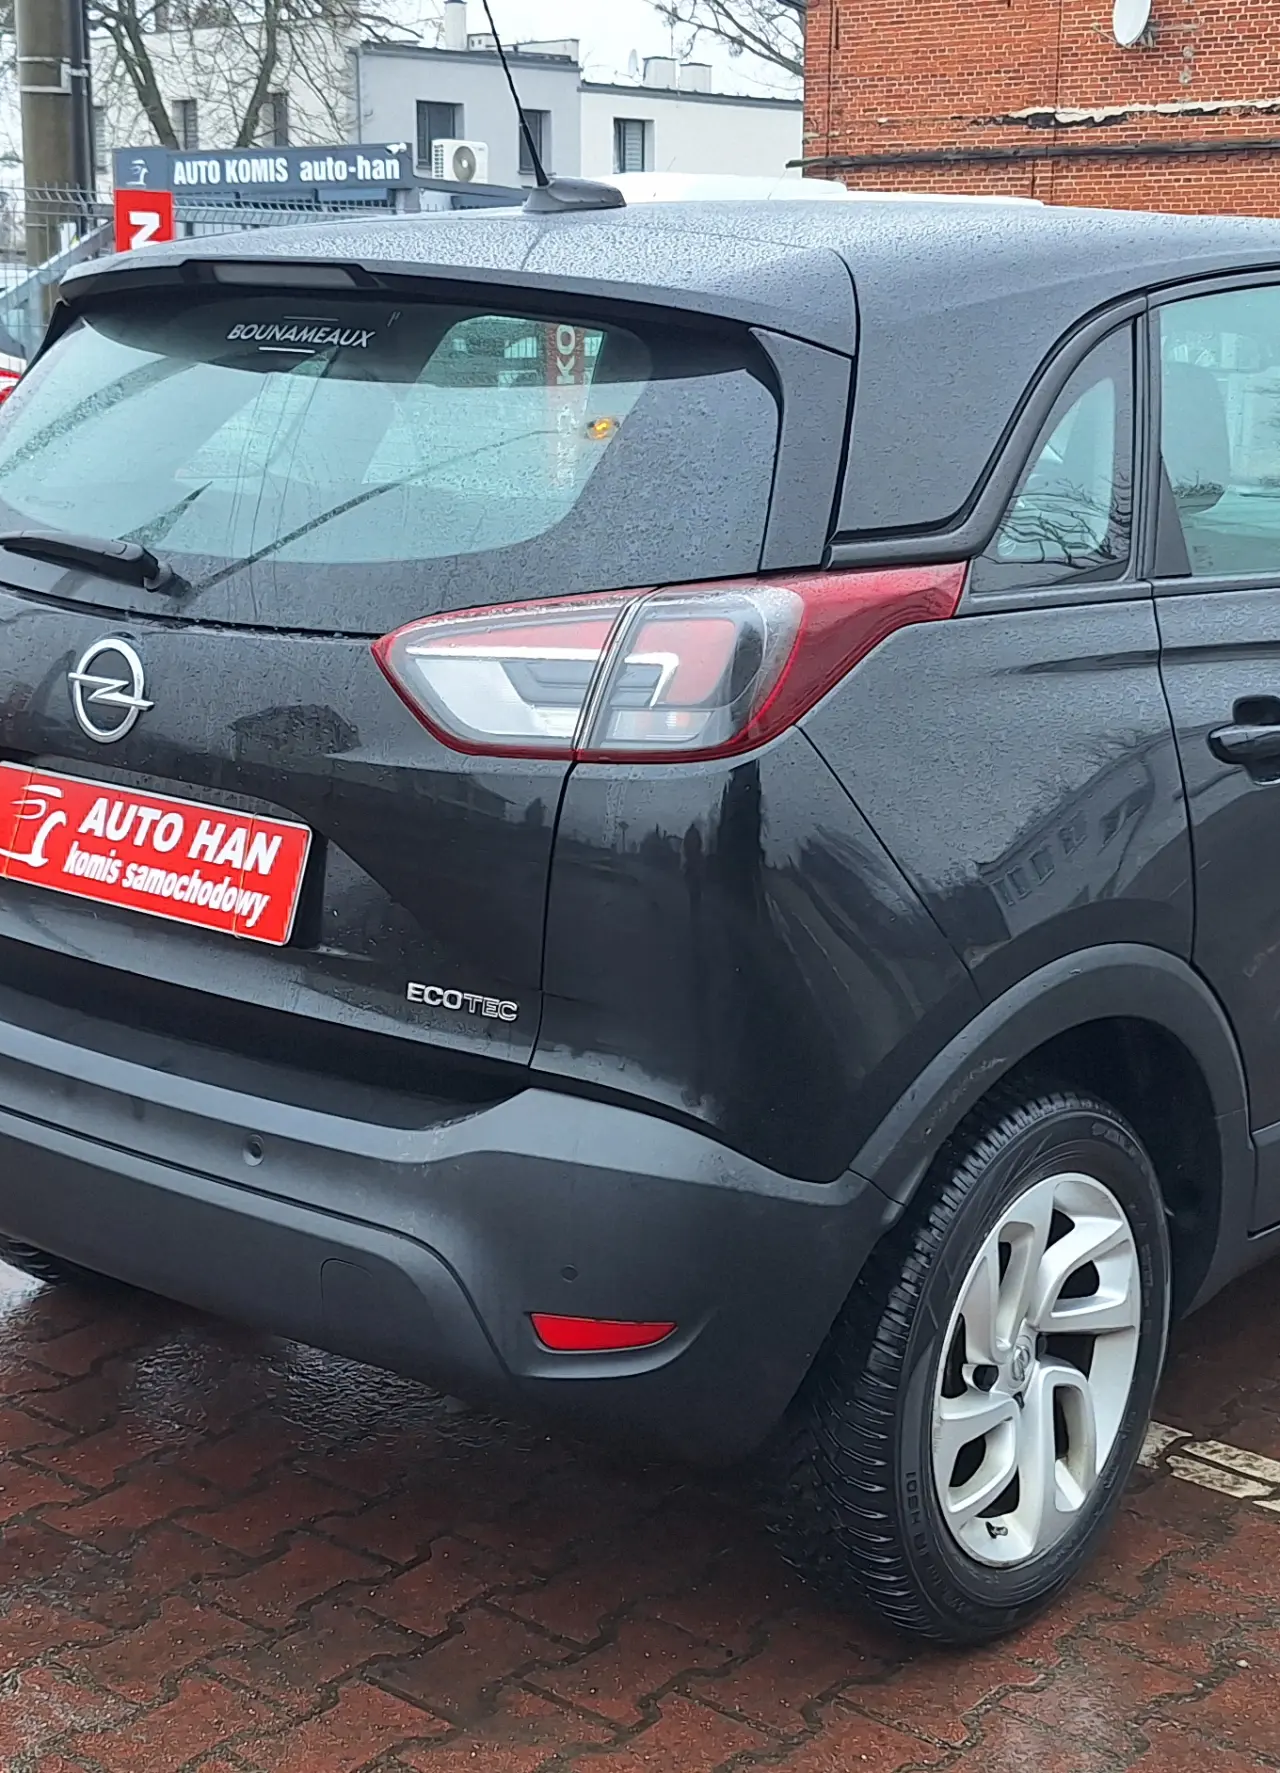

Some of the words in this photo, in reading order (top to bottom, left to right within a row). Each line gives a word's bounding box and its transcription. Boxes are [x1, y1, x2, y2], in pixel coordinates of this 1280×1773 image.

[173, 159, 221, 185] AUTO
[225, 157, 289, 183] KOMIS
[299, 155, 401, 182] auto-han
[227, 324, 375, 347] BOUNAMEAUX
[78, 797, 184, 853] AUTO
[187, 819, 283, 876] HAN
[62, 840, 124, 885] komis
[121, 861, 271, 929] samochodowy
[407, 982, 518, 1021] ECOTEC
